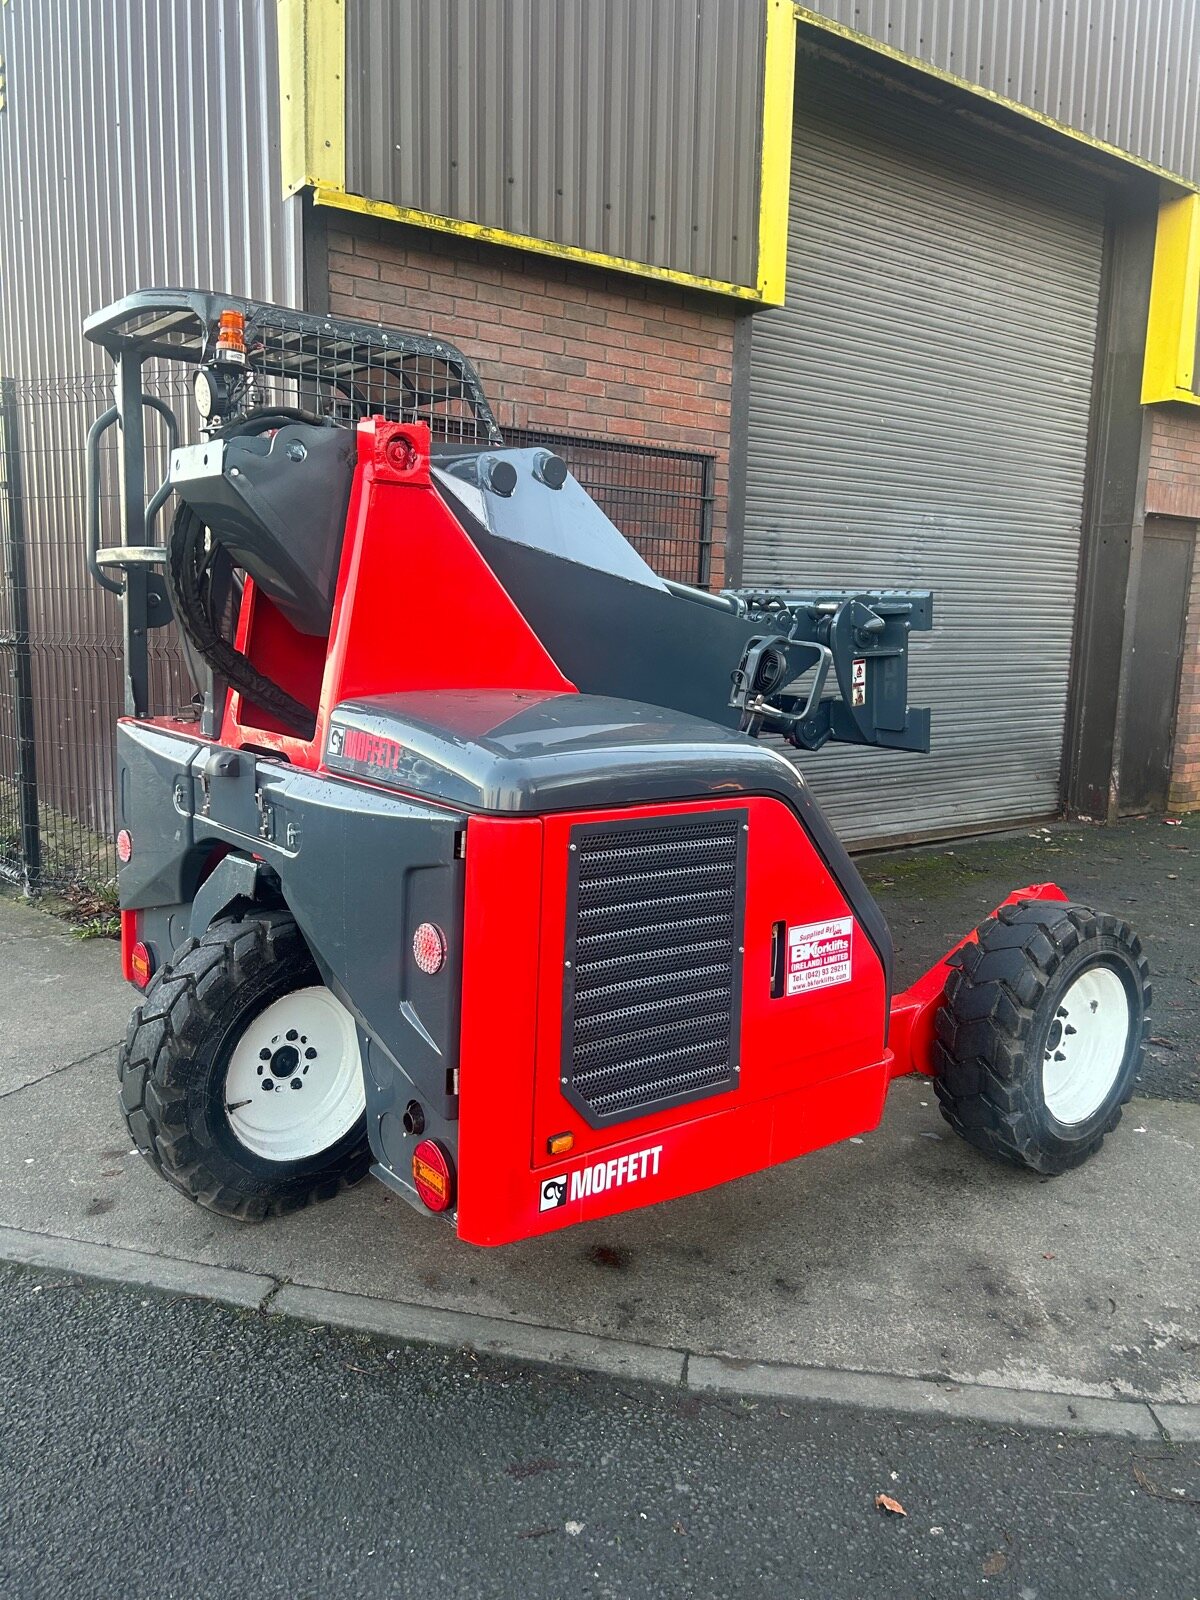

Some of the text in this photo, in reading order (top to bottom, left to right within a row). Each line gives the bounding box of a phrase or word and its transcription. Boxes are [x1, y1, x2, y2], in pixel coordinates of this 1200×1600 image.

[344, 729, 401, 770] MOFFETT
[800, 928, 824, 941] Supplied
[791, 958, 822, 972] (IRELAND)
[824, 952, 849, 964] LIMITED
[792, 974, 846, 990] www.bkforklifts.com
[793, 964, 847, 982] Tel. (042) 93 29211
[570, 1145, 663, 1202] MOFFETT
